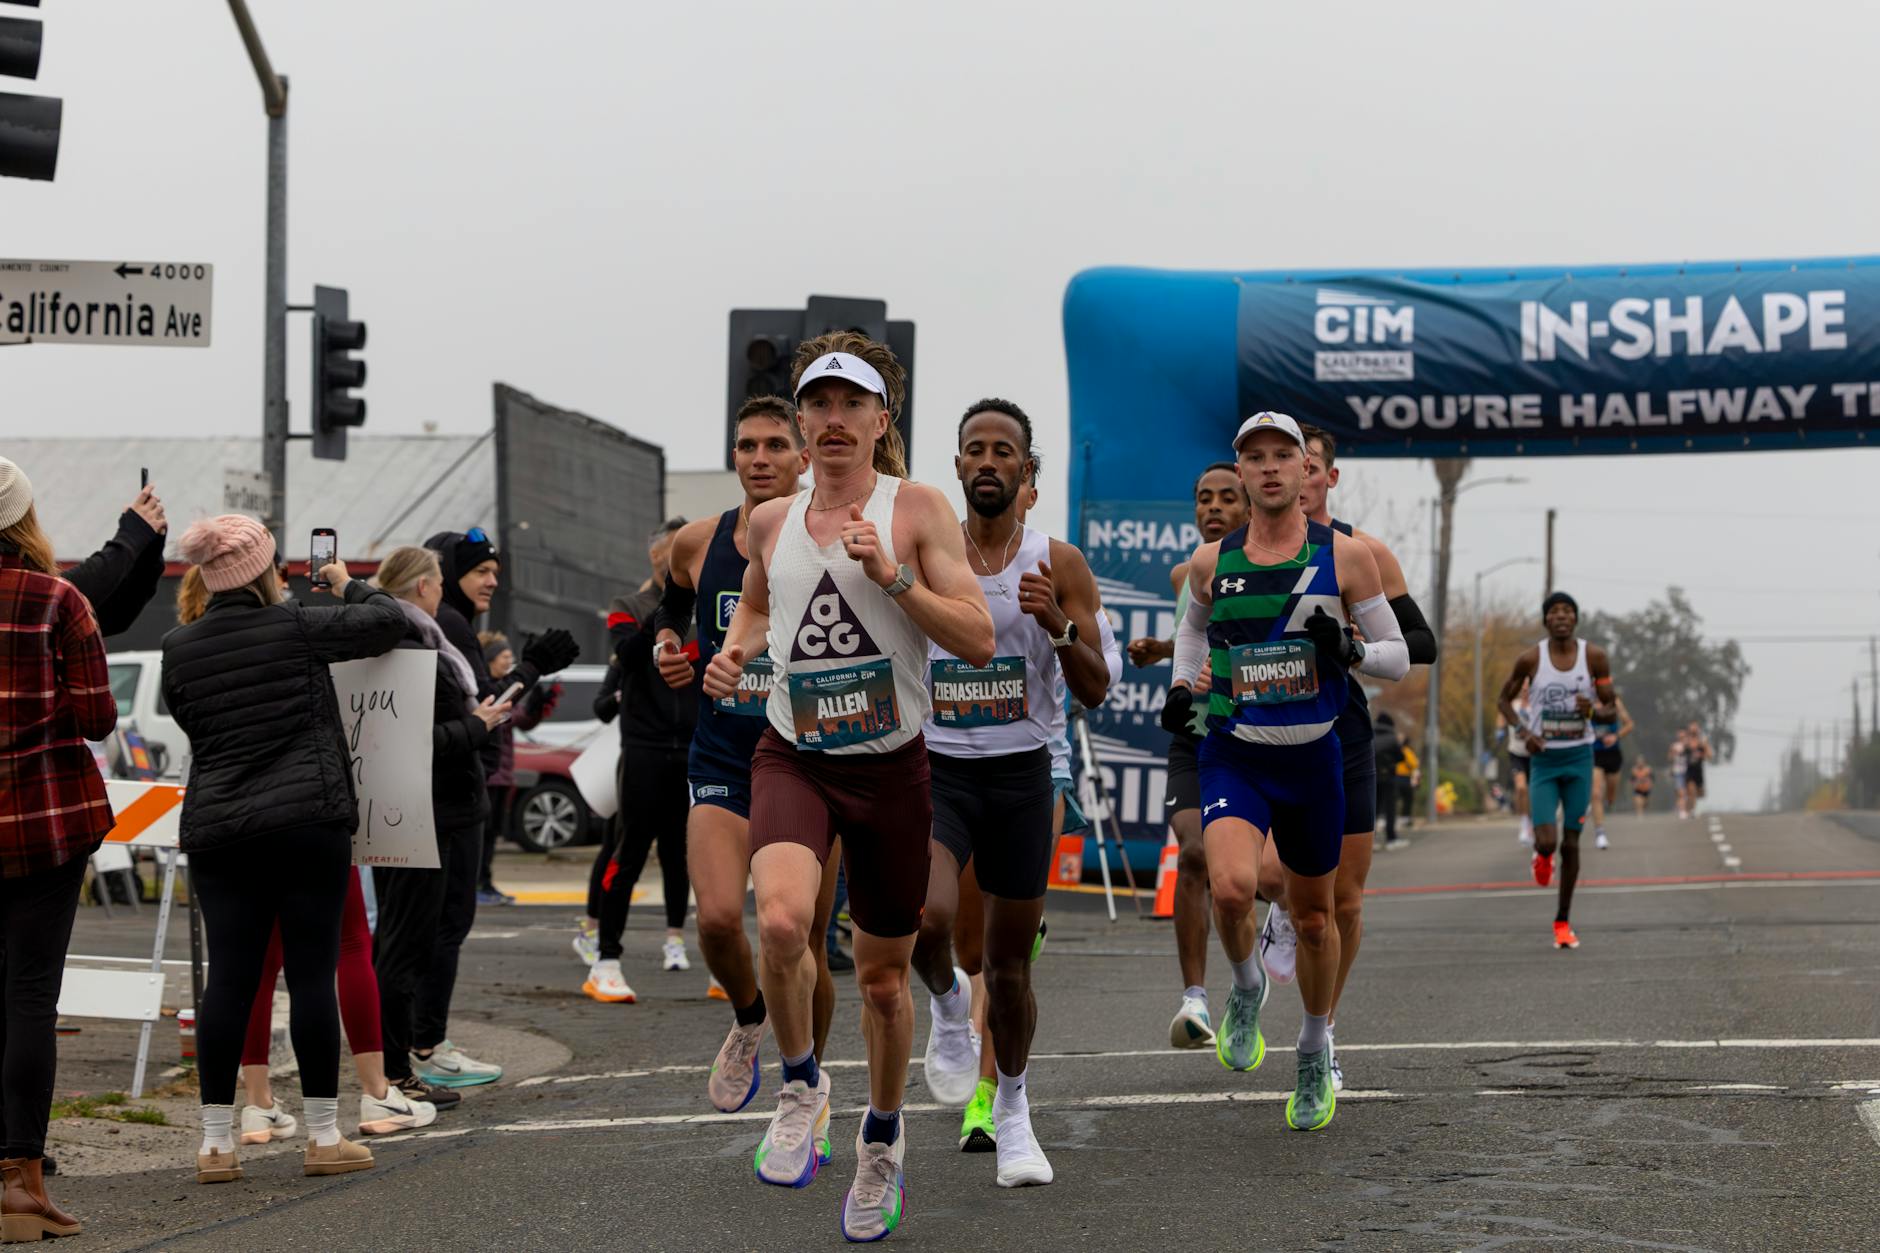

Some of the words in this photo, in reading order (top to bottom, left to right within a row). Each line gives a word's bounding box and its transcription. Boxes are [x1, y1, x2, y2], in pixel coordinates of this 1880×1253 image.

[39, 264, 70, 272] COUNTY
[150, 264, 205, 280] 4000
[164, 304, 202, 337] Ave
[1314, 305, 1414, 344] CIM
[1520, 291, 1847, 361] IN-SHAPE
[1345, 394, 1543, 430] YOU'RE
[1560, 384, 1818, 425] HALFWAY
[816, 672, 857, 684] CALIFORNIA
[1240, 659, 1306, 683] THOMSON
[817, 690, 868, 720] ALLEN
[933, 679, 1024, 702] ZIENASELLASSIE
[351, 690, 398, 752] you
